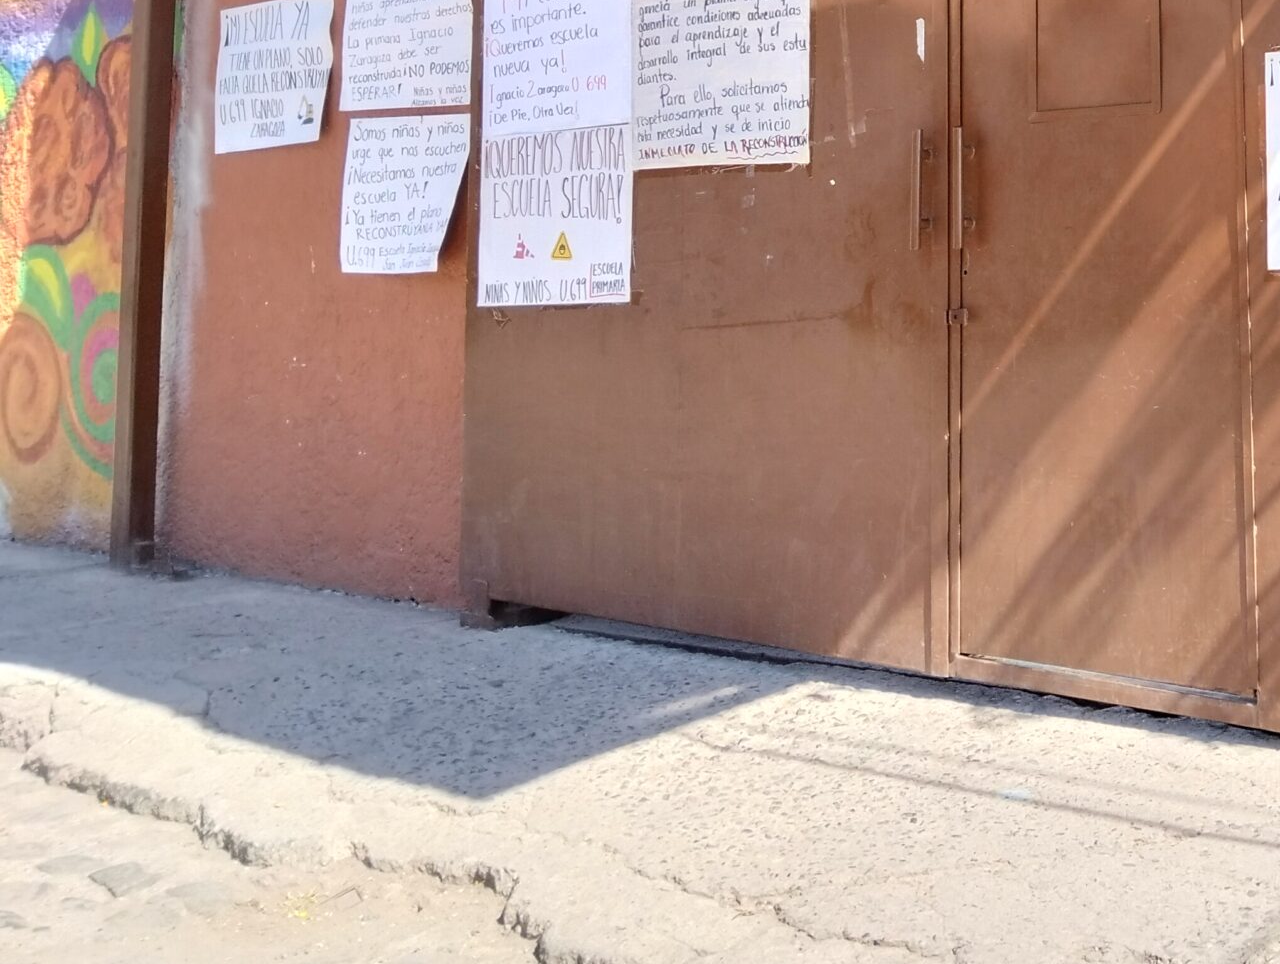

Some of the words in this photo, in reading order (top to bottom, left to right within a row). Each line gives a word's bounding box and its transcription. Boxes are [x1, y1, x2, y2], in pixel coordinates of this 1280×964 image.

[491, 18, 506, 35] es
[512, 3, 586, 34] importante.
[485, 37, 544, 58] ¡Queremos
[550, 24, 599, 45] escuela
[493, 60, 530, 78] nueva
[540, 49, 567, 75] ya!
[490, 84, 524, 109] Ignacio
[586, 75, 607, 91] 699
[533, 104, 554, 119] Otra
[485, 131, 563, 178] ¡QUEREMOS
[570, 127, 625, 173] NUESTRA
[493, 178, 552, 219] ESCUELA
[561, 172, 623, 224] SEGURA!
[592, 262, 623, 276] ESCUELA
